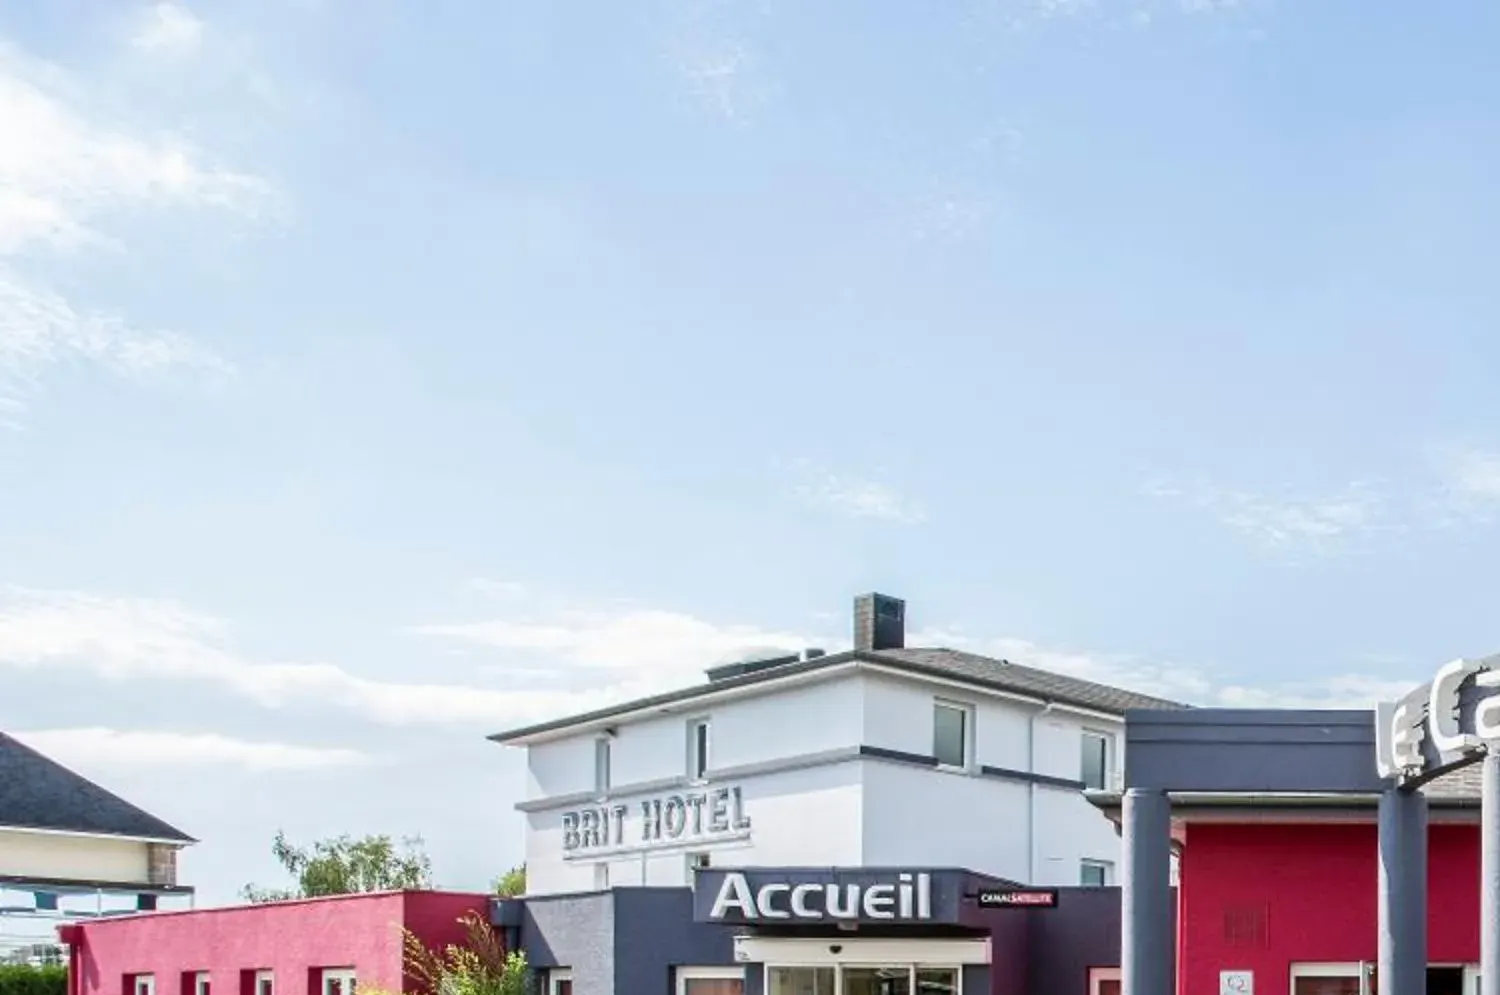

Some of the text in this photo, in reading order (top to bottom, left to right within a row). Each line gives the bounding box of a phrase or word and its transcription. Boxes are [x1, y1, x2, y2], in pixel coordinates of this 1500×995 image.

[563, 787, 751, 850] BRIT HOTEL
[710, 872, 931, 918] Accueil
